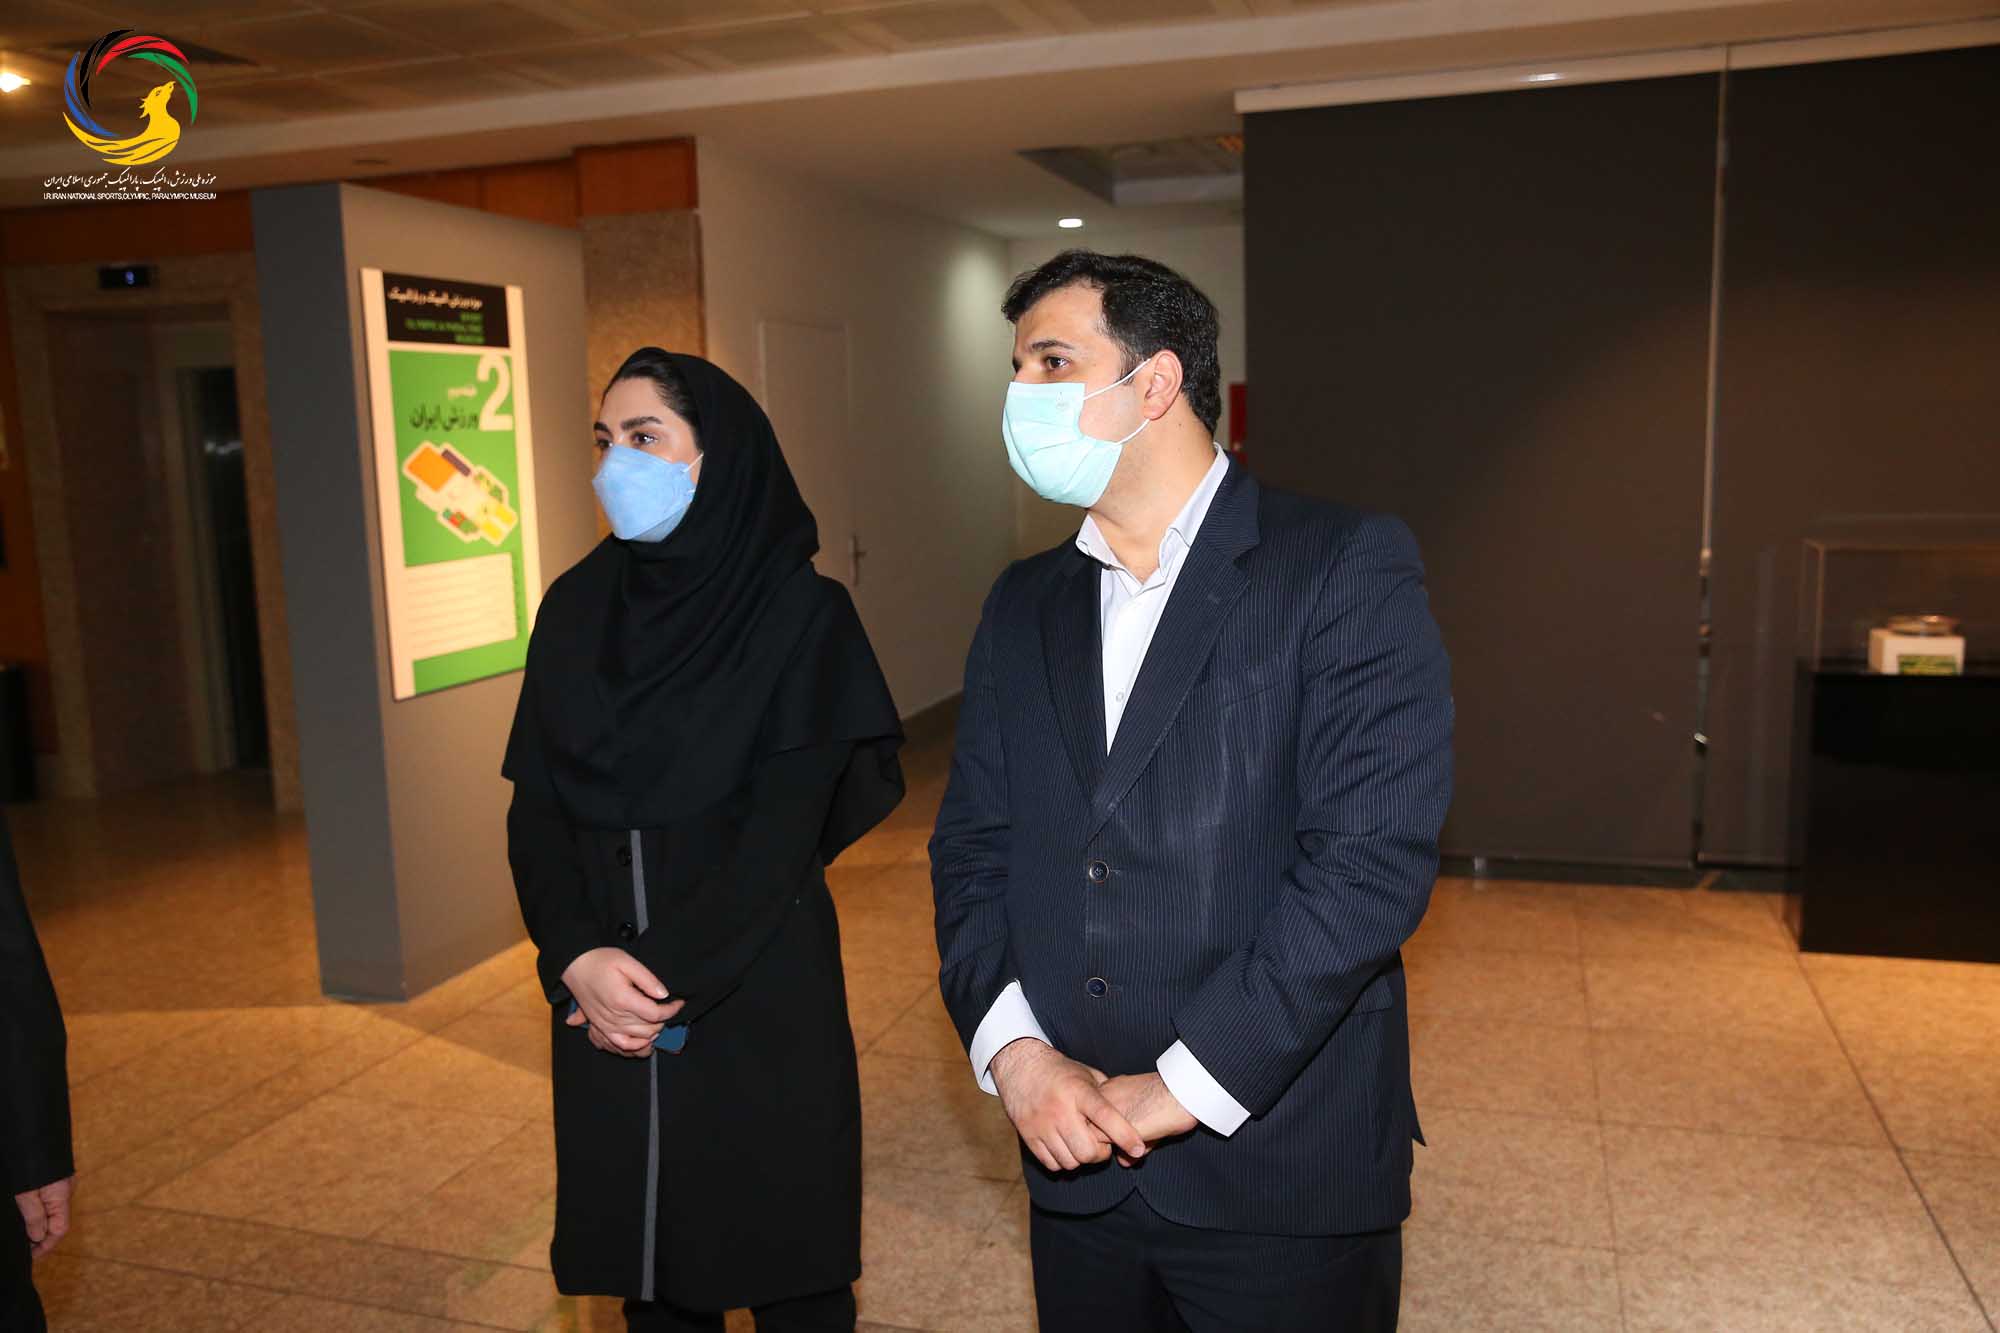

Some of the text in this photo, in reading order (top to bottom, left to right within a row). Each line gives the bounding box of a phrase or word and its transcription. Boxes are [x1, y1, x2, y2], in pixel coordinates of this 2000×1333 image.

[408, 402, 479, 432] ورزش ایران
[477, 352, 512, 431] 2
